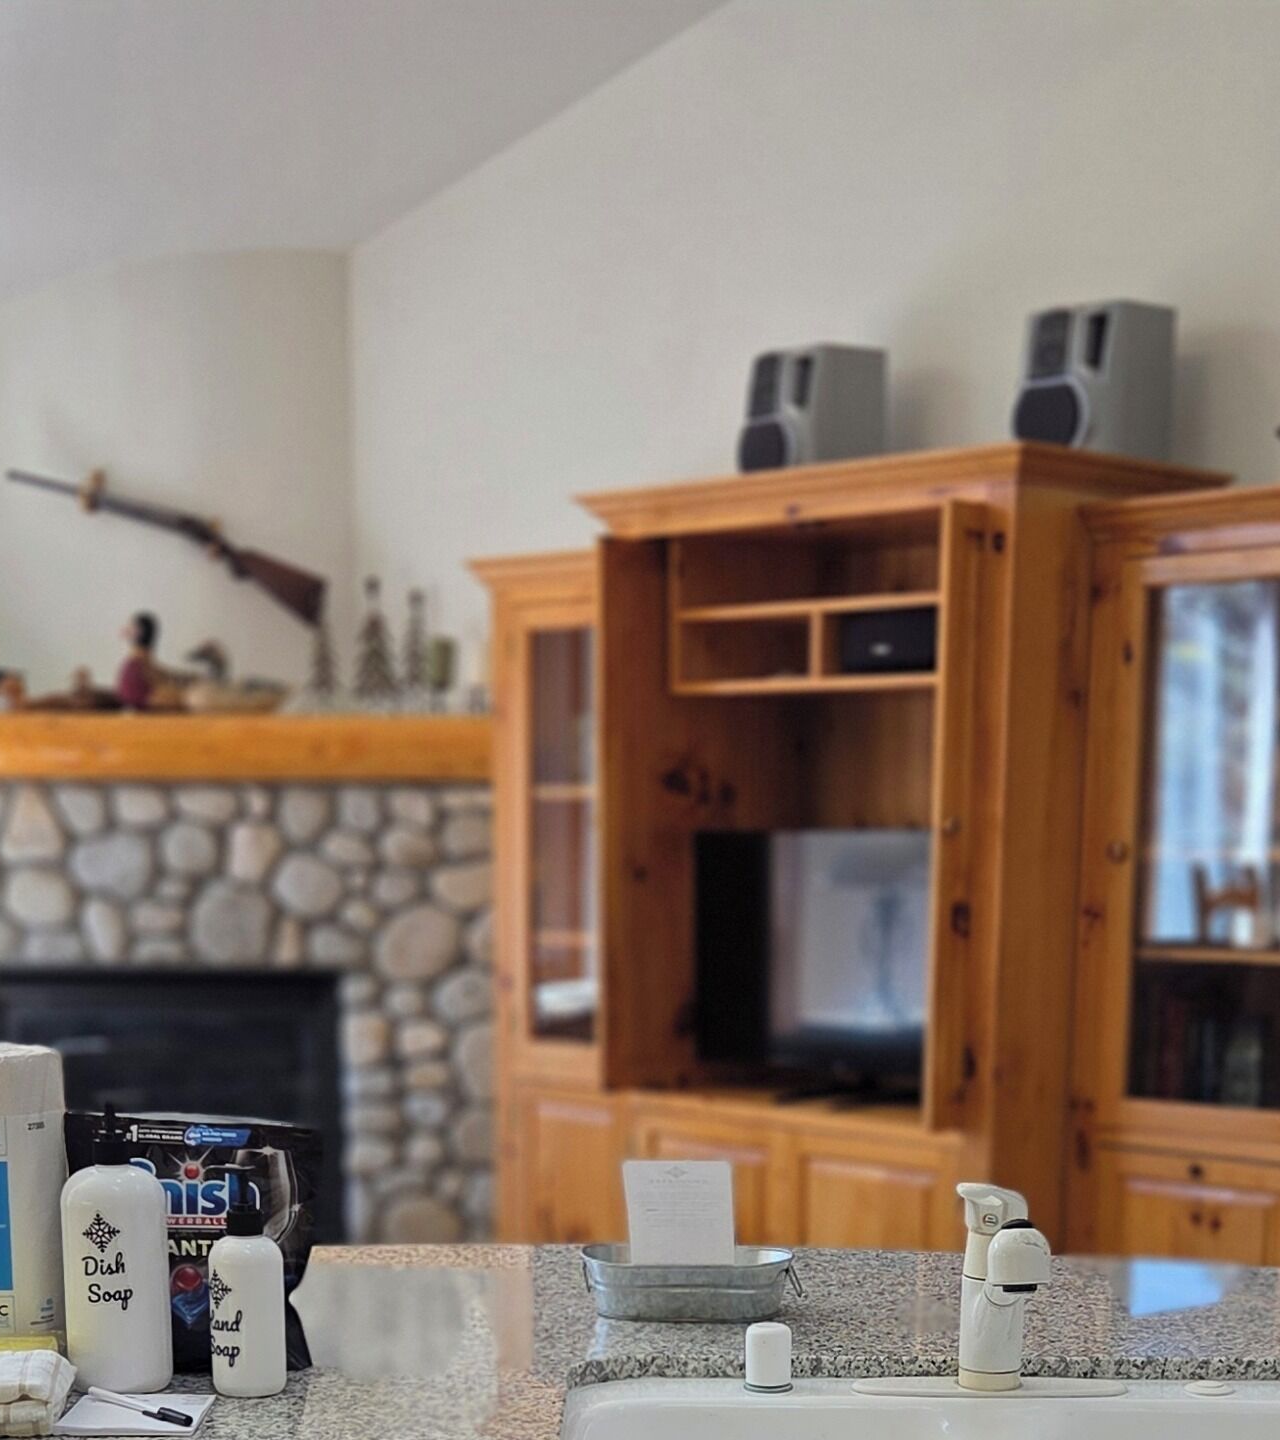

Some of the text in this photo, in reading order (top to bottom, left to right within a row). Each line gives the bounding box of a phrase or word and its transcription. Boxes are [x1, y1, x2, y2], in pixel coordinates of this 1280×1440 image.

[129, 1157, 260, 1215] nish
[167, 1217, 227, 1225] WERBALL
[167, 1239, 214, 1257] ANT
[82, 1252, 126, 1276] Dish
[88, 1283, 133, 1311] Soap
